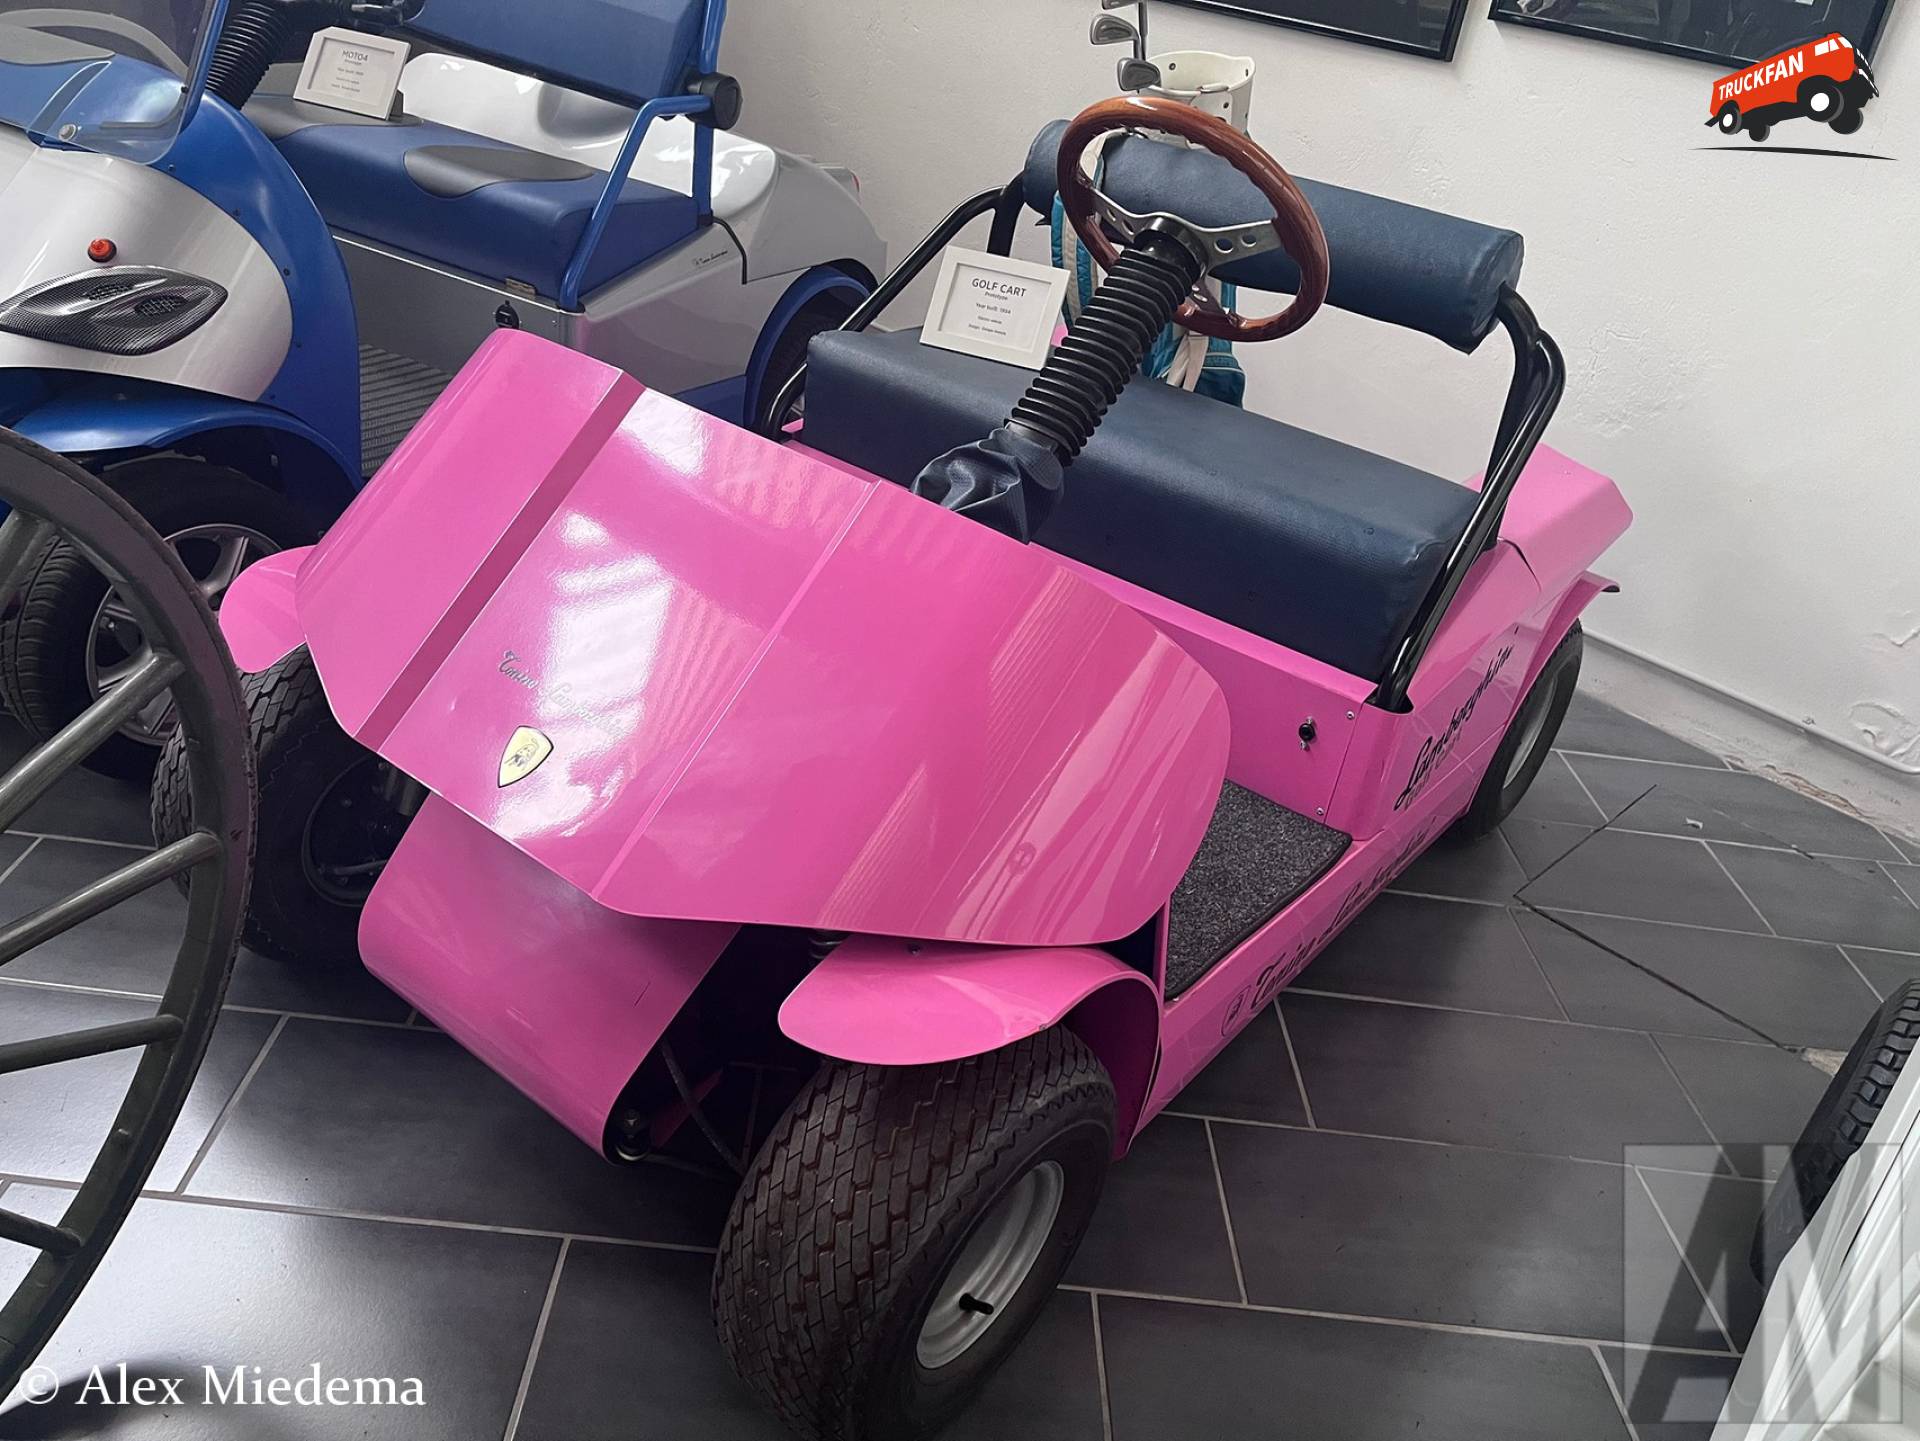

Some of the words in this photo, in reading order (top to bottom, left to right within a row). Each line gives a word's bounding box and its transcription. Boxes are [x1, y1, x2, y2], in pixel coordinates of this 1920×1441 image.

[342, 50, 369, 62] MOTO4
[971, 278, 999, 291] GOLF
[1000, 284, 1027, 297] CART
[498, 650, 541, 690] Tonino
[1393, 625, 1519, 811] Lamborghini
